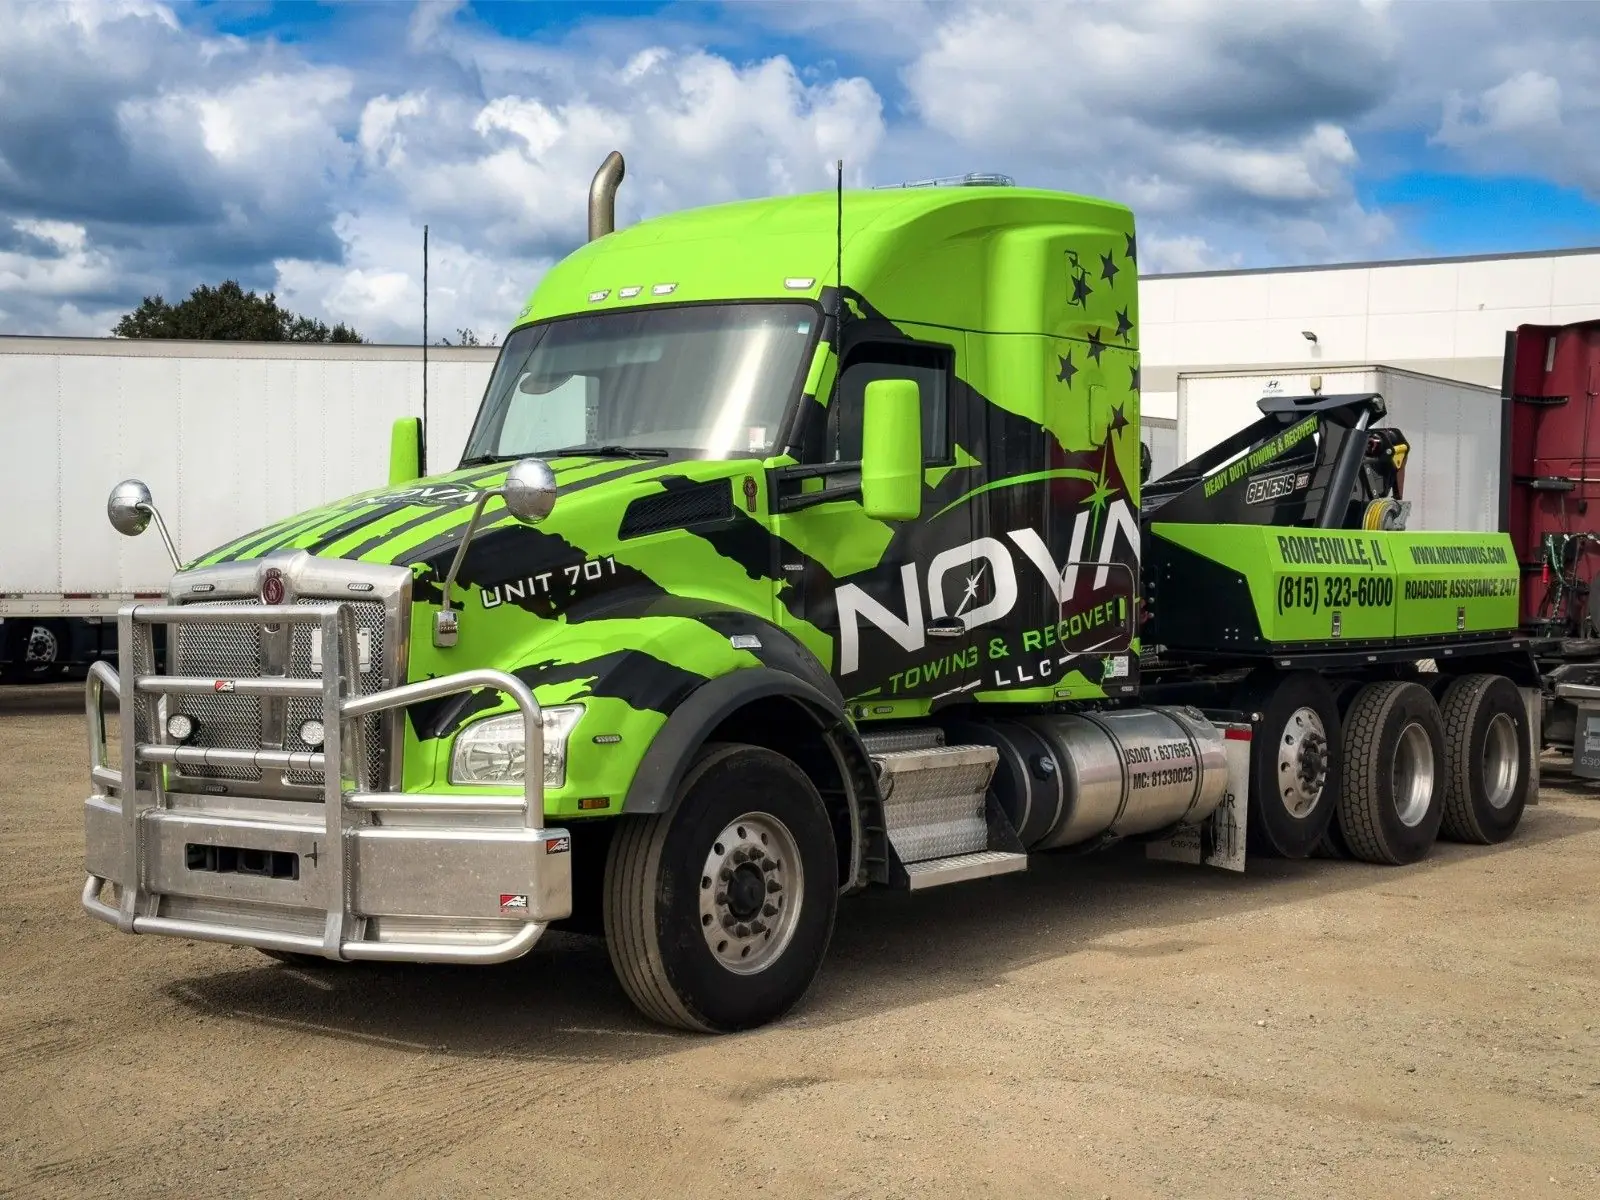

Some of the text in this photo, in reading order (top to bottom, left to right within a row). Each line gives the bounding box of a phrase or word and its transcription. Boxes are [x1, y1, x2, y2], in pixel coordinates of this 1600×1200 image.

[1204, 415, 1318, 498] HEAVY DUTY TOWING & RECOVERY
[1246, 474, 1295, 505] GENESIS
[1277, 535, 1387, 571] ROMEOVILLE, IL
[1409, 546, 1508, 565] WWW.NOVATOWUS.COM
[481, 556, 617, 608] UNIT 701
[835, 499, 1140, 676] NOVA
[1278, 576, 1394, 616] (815) 323-6000
[1405, 578, 1518, 600] ROADSIDE ASSISTANCE 24/7
[889, 646, 979, 694] TOWING
[989, 638, 1010, 659] &
[995, 658, 1052, 687] LLC
[1124, 746, 1153, 765] USDOT
[1133, 766, 1193, 790] MC: 81330025
